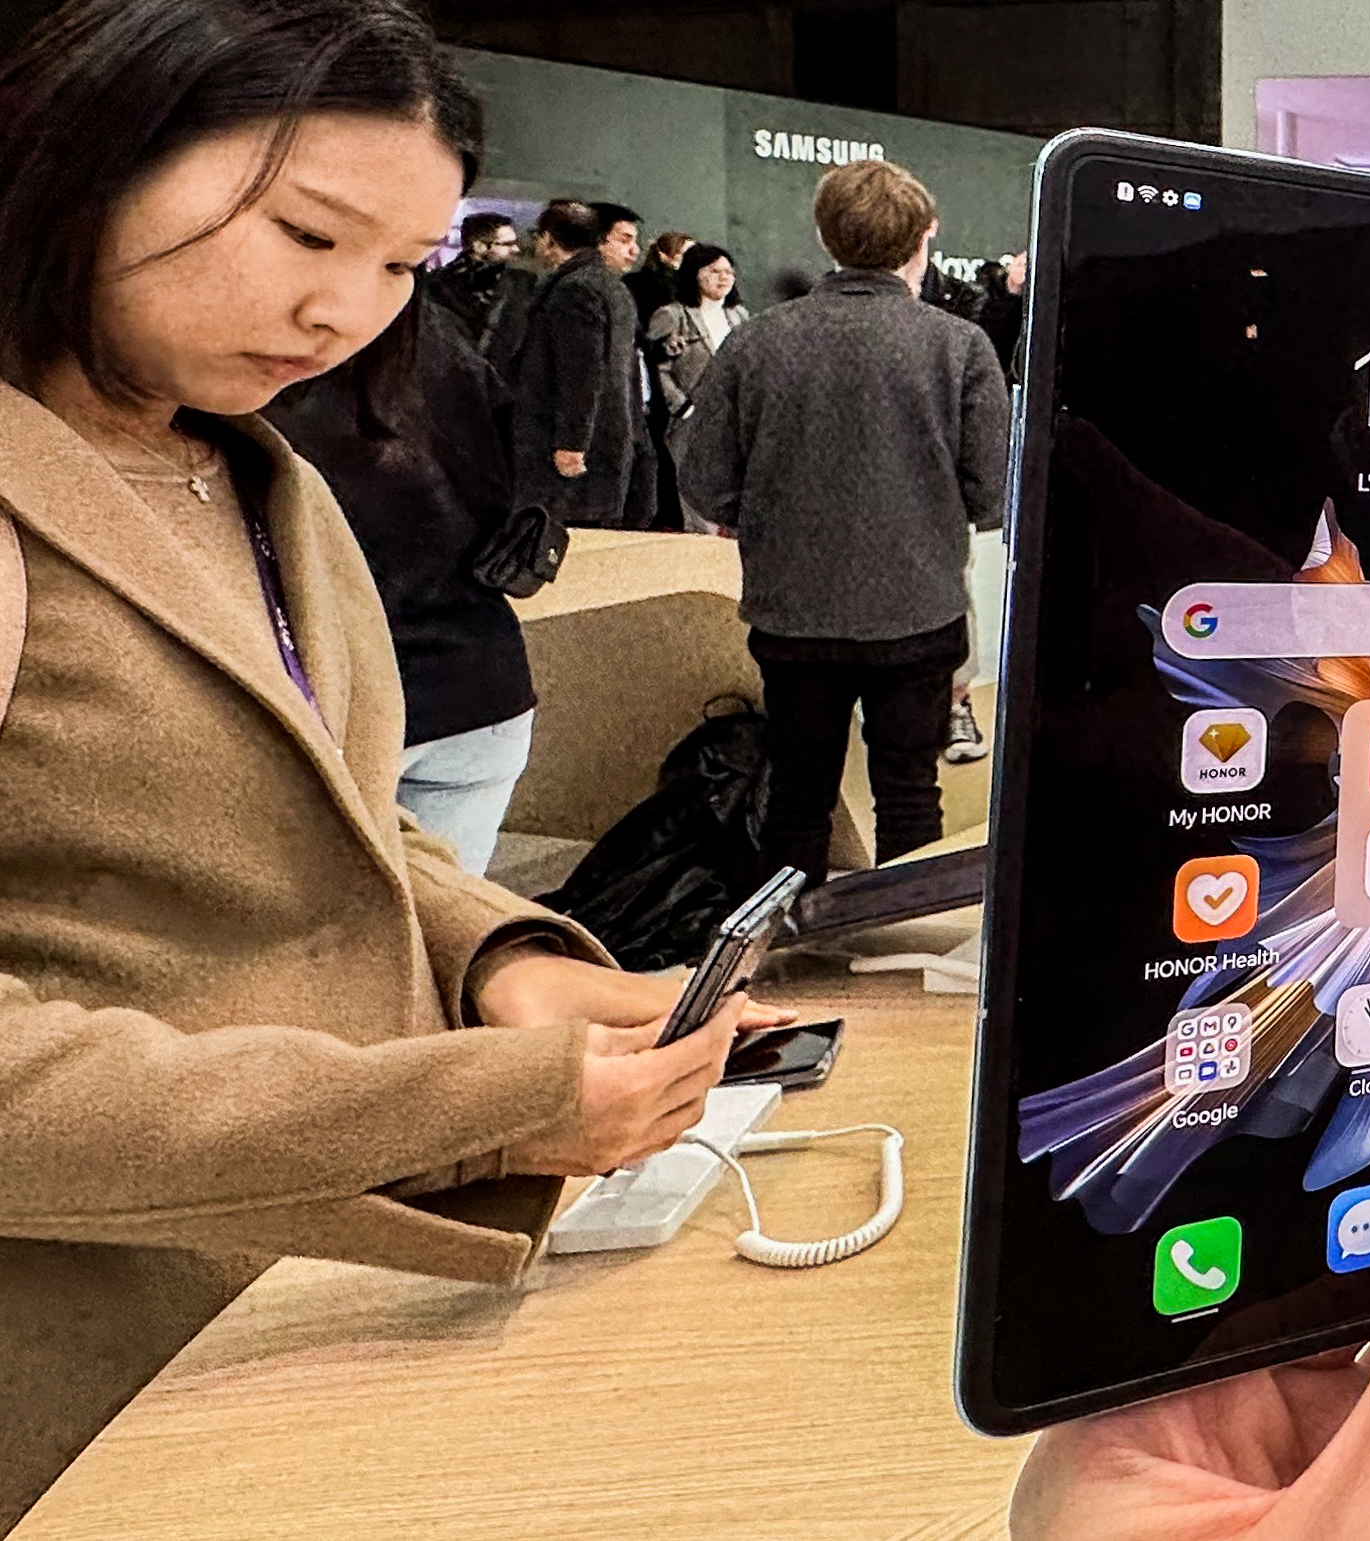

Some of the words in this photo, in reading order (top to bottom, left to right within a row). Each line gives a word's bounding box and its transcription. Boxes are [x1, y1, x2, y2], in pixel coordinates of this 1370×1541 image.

[754, 129, 884, 166] SAMSUNG
[1182, 603, 1218, 638] G
[1199, 767, 1247, 780] HONOR
[1168, 808, 1198, 830] My
[1201, 803, 1272, 824] HONOR
[1144, 955, 1218, 980] HONOR
[1222, 948, 1280, 970] Health
[1172, 1102, 1239, 1129] Google
